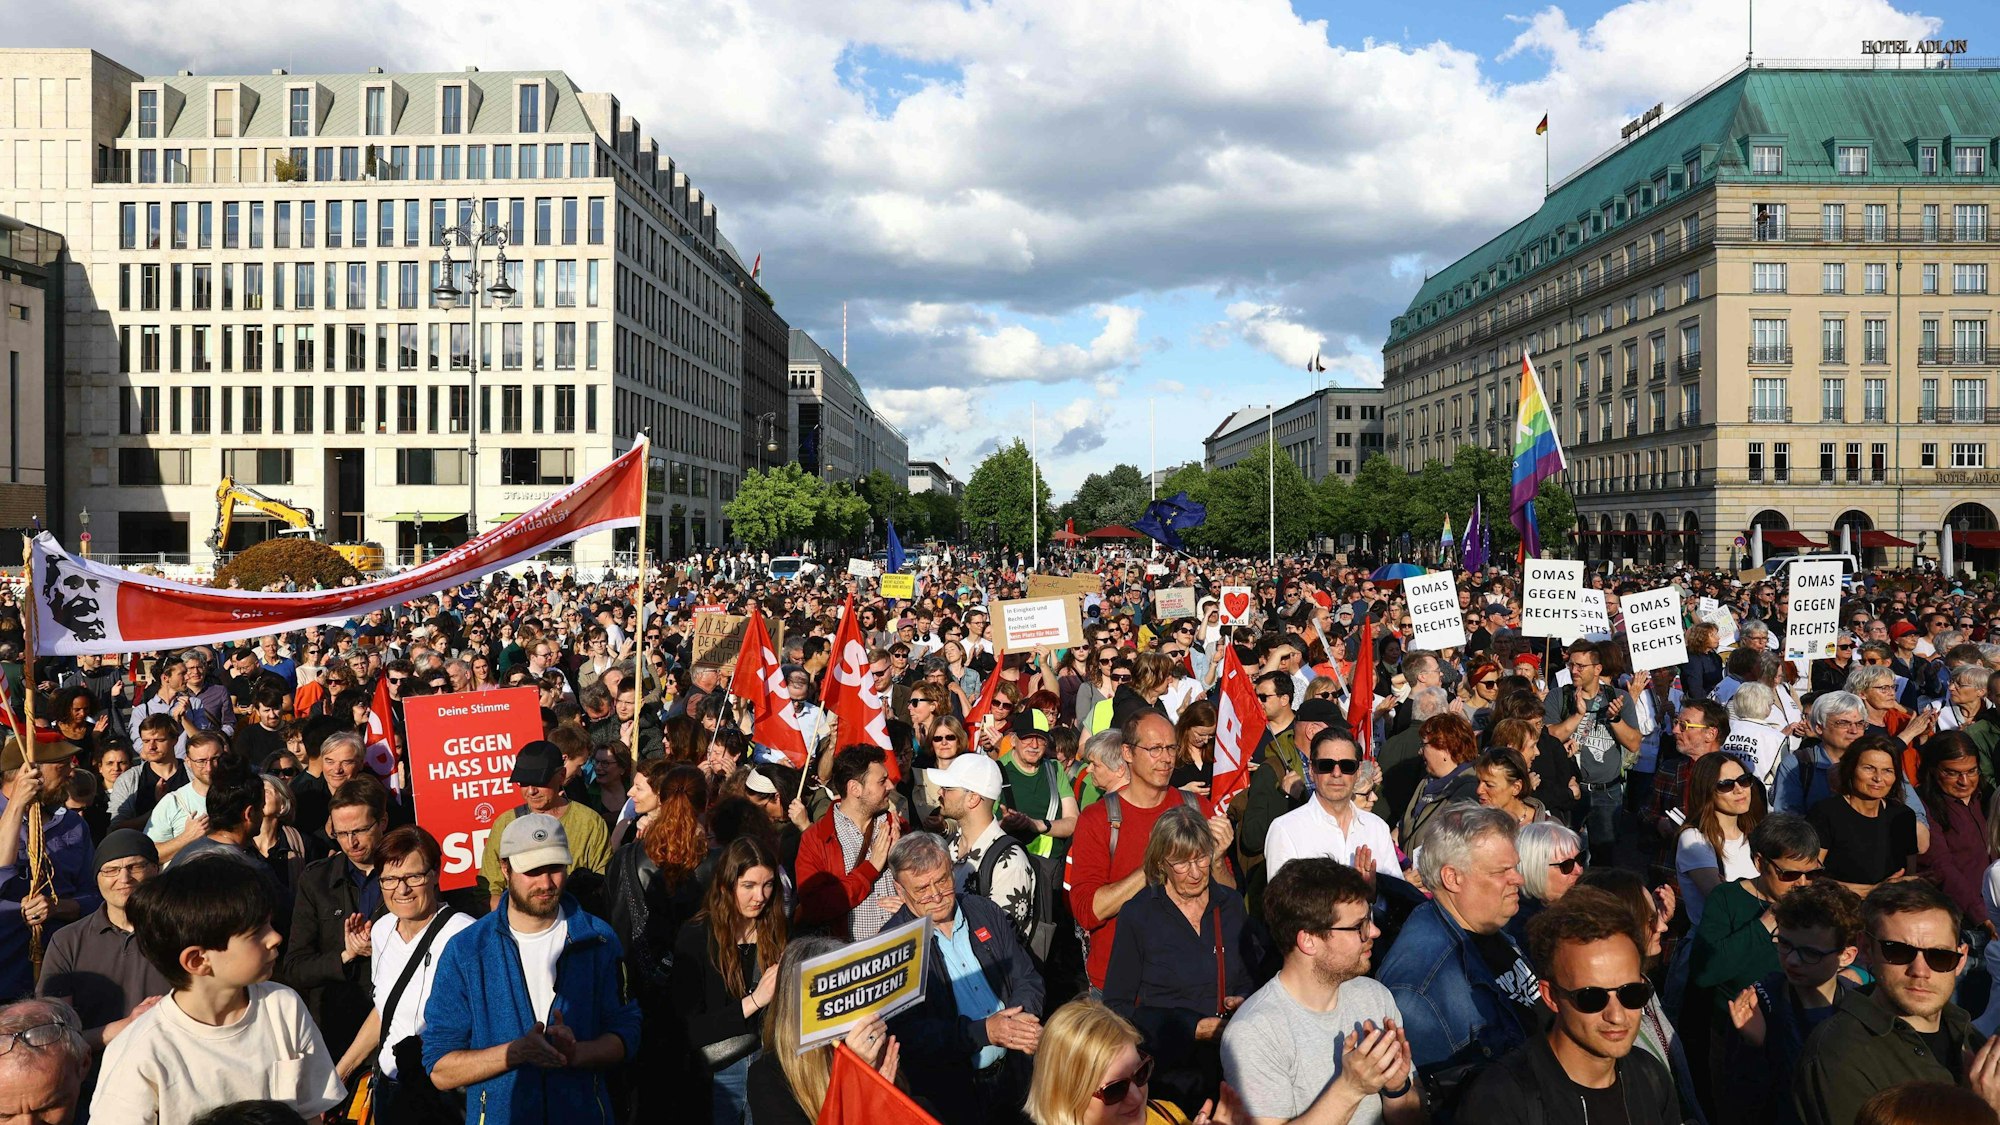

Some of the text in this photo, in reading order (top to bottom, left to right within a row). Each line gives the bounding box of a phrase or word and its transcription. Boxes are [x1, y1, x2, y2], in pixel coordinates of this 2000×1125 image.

[1862, 39, 1968, 54] HOTEL ADLON
[1936, 472, 2000, 484] HOTEL ADLO
[1532, 569, 1575, 581] OMAS
[1798, 574, 1835, 588] OMAS
[1412, 580, 1449, 596] OMAS
[1528, 588, 1576, 601] GEGEN
[1414, 599, 1454, 615] GEGEN
[1581, 595, 1599, 605] AS
[1630, 597, 1670, 614] OMAS
[1794, 598, 1835, 612] GEGEN
[1013, 606, 1036, 614] Einigkeit
[1525, 607, 1578, 620] RECHTS
[1580, 609, 1603, 619] GEN
[699, 617, 740, 636] NAZIS
[1415, 617, 1461, 634] RECHTS
[1579, 624, 1608, 635] CHTS
[1631, 616, 1676, 633] GEGEN
[1790, 621, 1836, 636] RECHTS
[698, 636, 741, 650] DER LEIT
[1632, 634, 1682, 653] RECHTS
[697, 650, 739, 664] SCHUBS
[438, 703, 510, 717] Deine Stimme
[443, 732, 512, 756] GEGEN
[1729, 734, 1758, 746] OMAS
[1723, 743, 1757, 754] GEGEN
[1730, 752, 1759, 764] HTS
[428, 754, 517, 780] HASS UN
[452, 776, 514, 800] HETZE
[442, 828, 493, 874] SP
[817, 944, 910, 994] DEMOKRATIE
[823, 972, 904, 1017] SCHÜTZEN!
